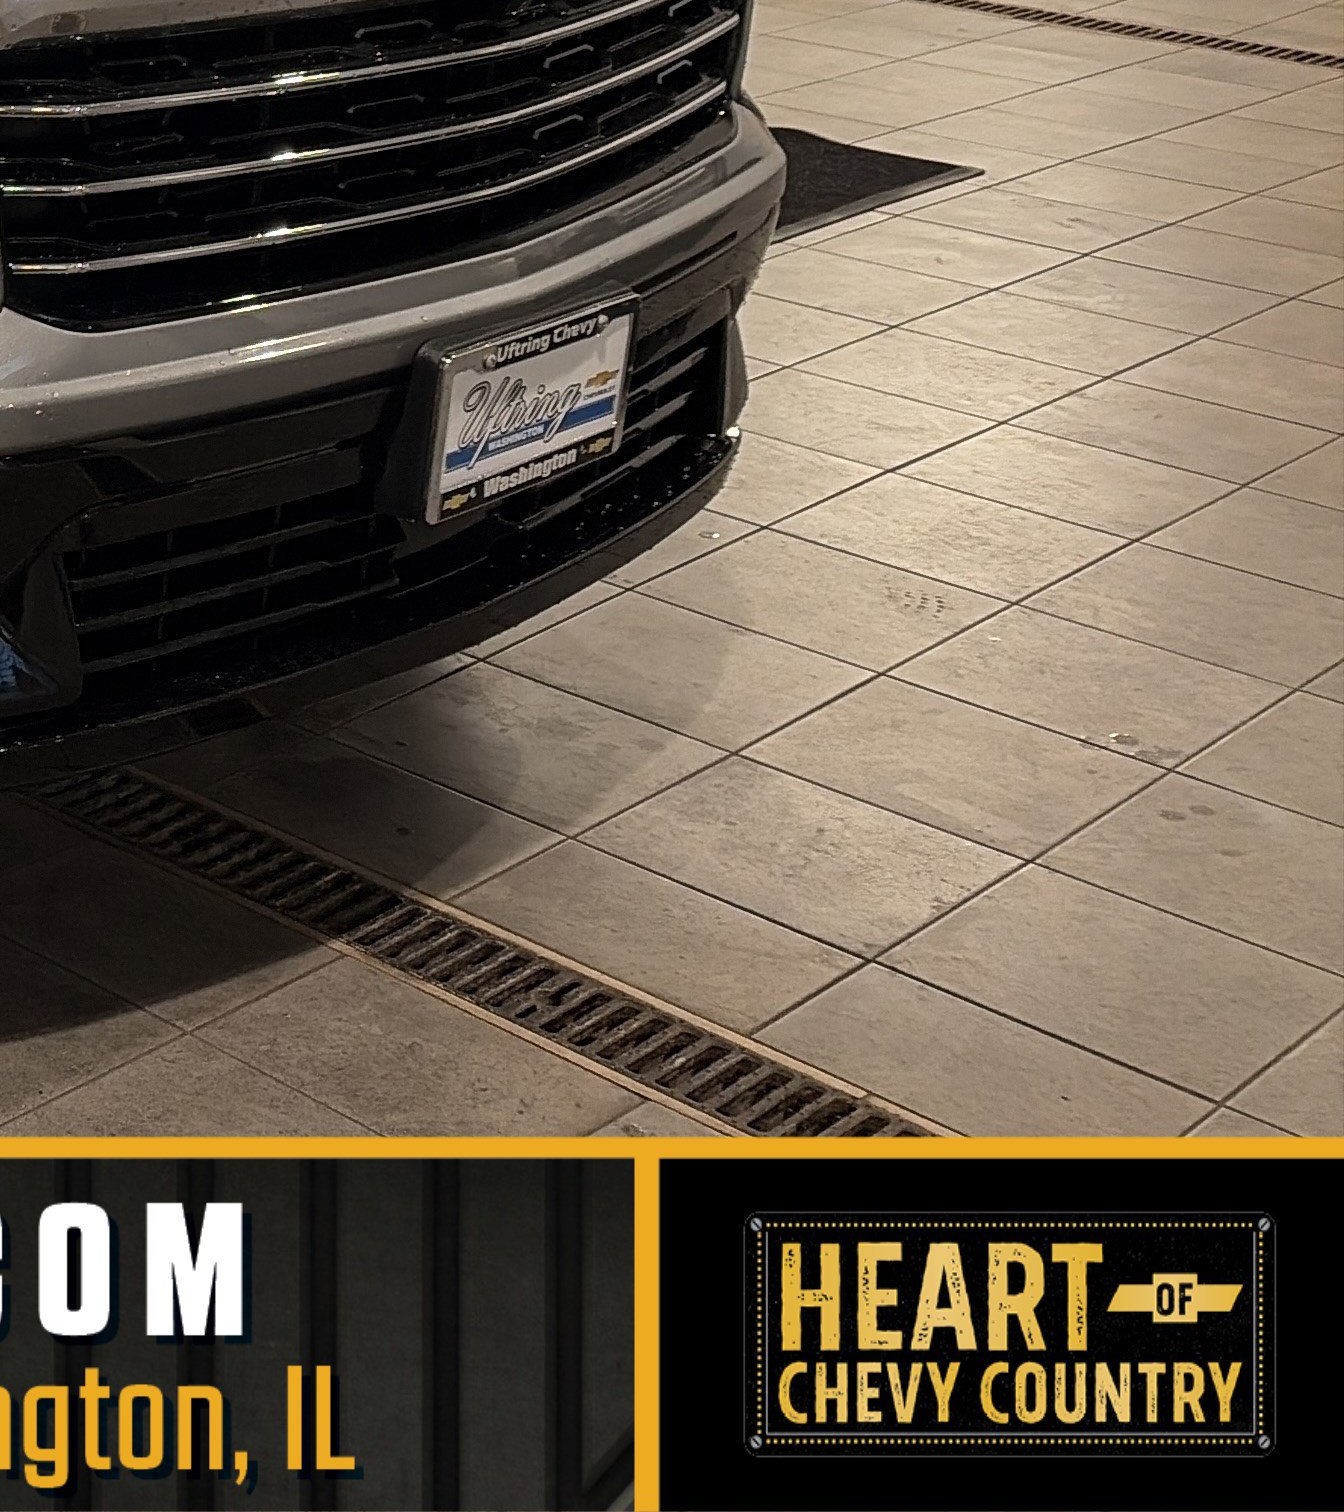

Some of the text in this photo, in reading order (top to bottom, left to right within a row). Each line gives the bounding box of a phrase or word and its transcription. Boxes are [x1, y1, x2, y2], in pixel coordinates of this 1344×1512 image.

[497, 317, 598, 363] Uftring Chevy
[458, 376, 582, 470] Uftring
[483, 449, 578, 499] Washington
